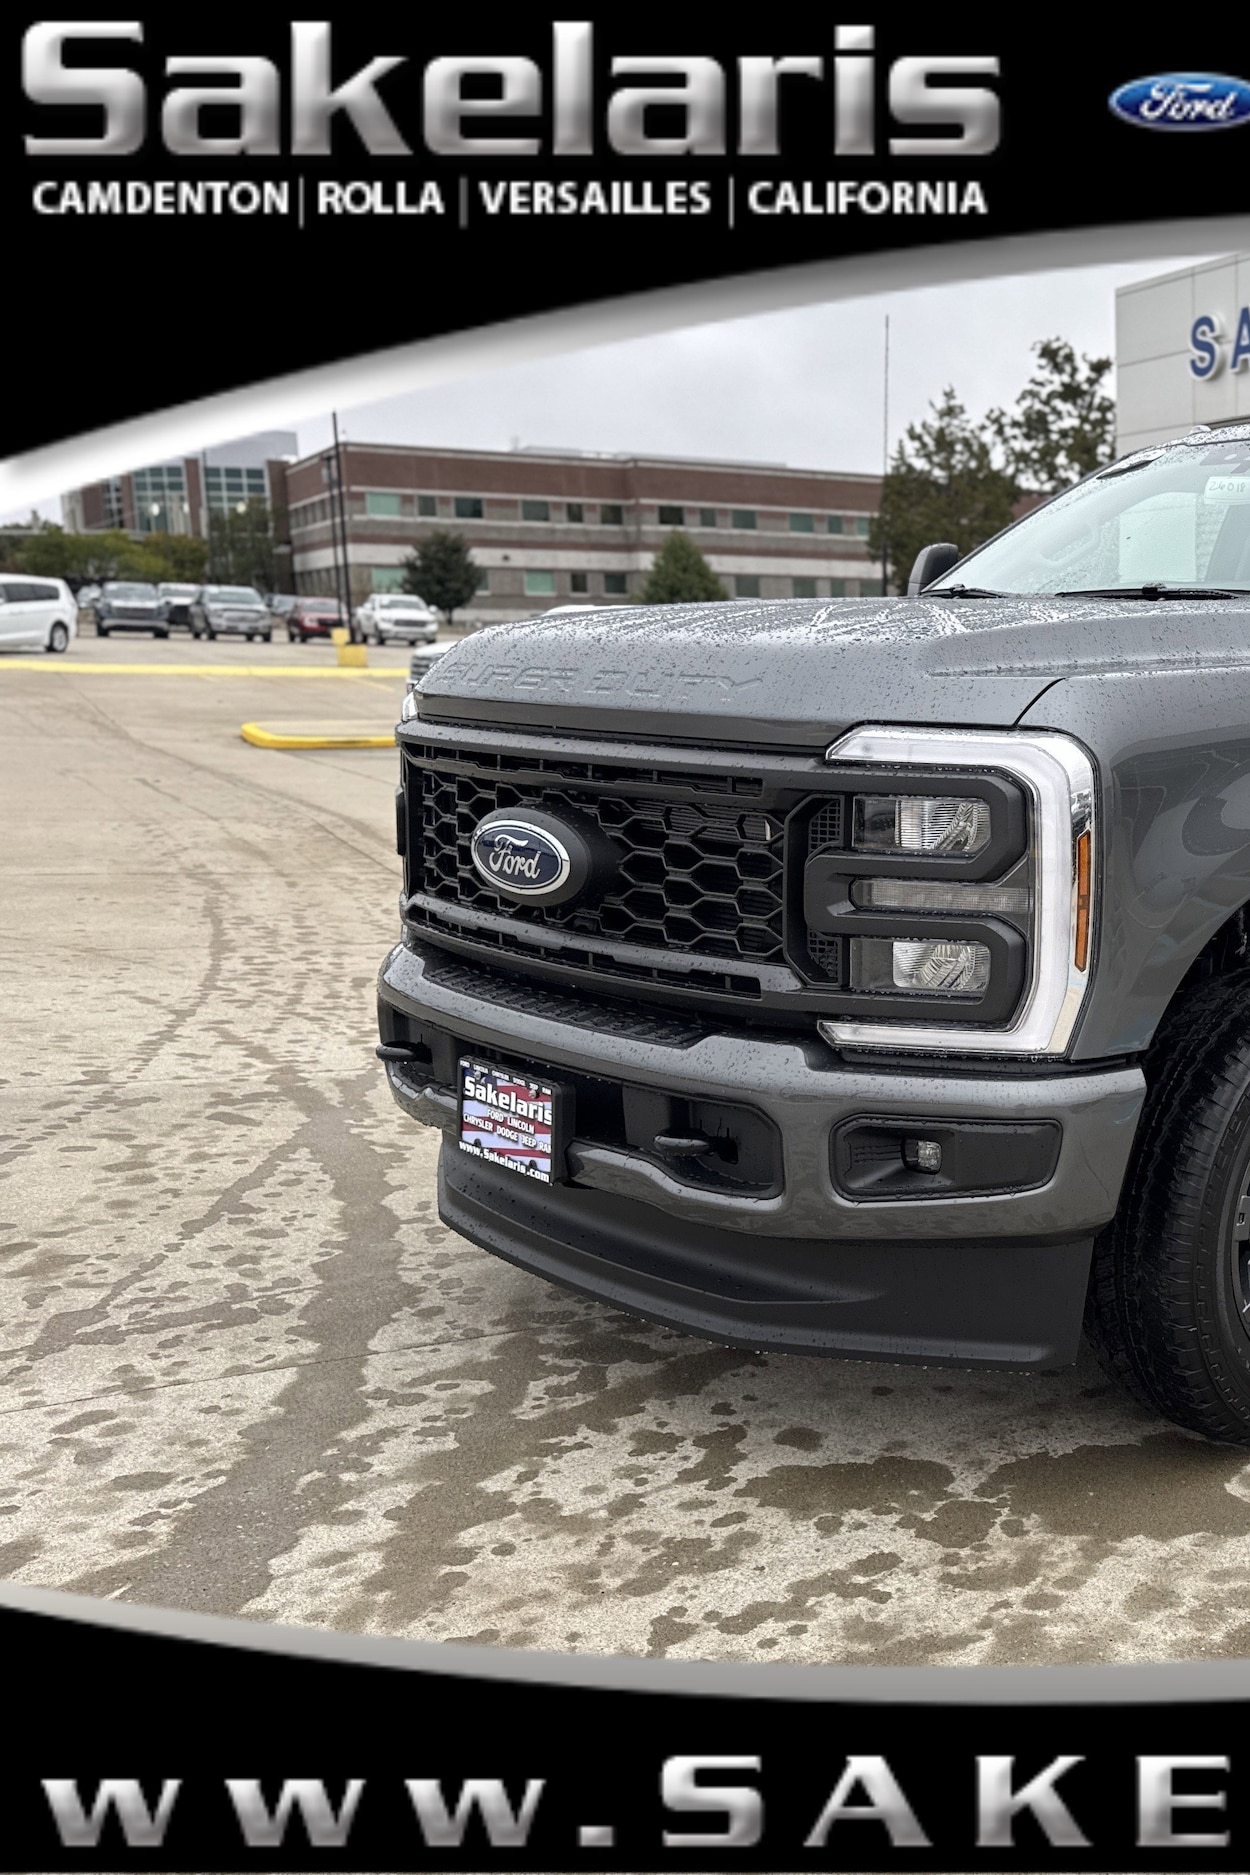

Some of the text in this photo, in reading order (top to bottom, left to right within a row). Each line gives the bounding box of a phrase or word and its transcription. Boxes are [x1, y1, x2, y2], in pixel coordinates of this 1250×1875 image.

[440, 661, 579, 692] SUPER
[488, 833, 541, 880] Ford
[464, 1075, 552, 1126] Sakelaris
[464, 1113, 493, 1132] CHRYSLER
[497, 1126, 518, 1141] DODGE
[522, 1135, 536, 1148] JEEP
[487, 1109, 534, 1134] FORD LINCOLN
